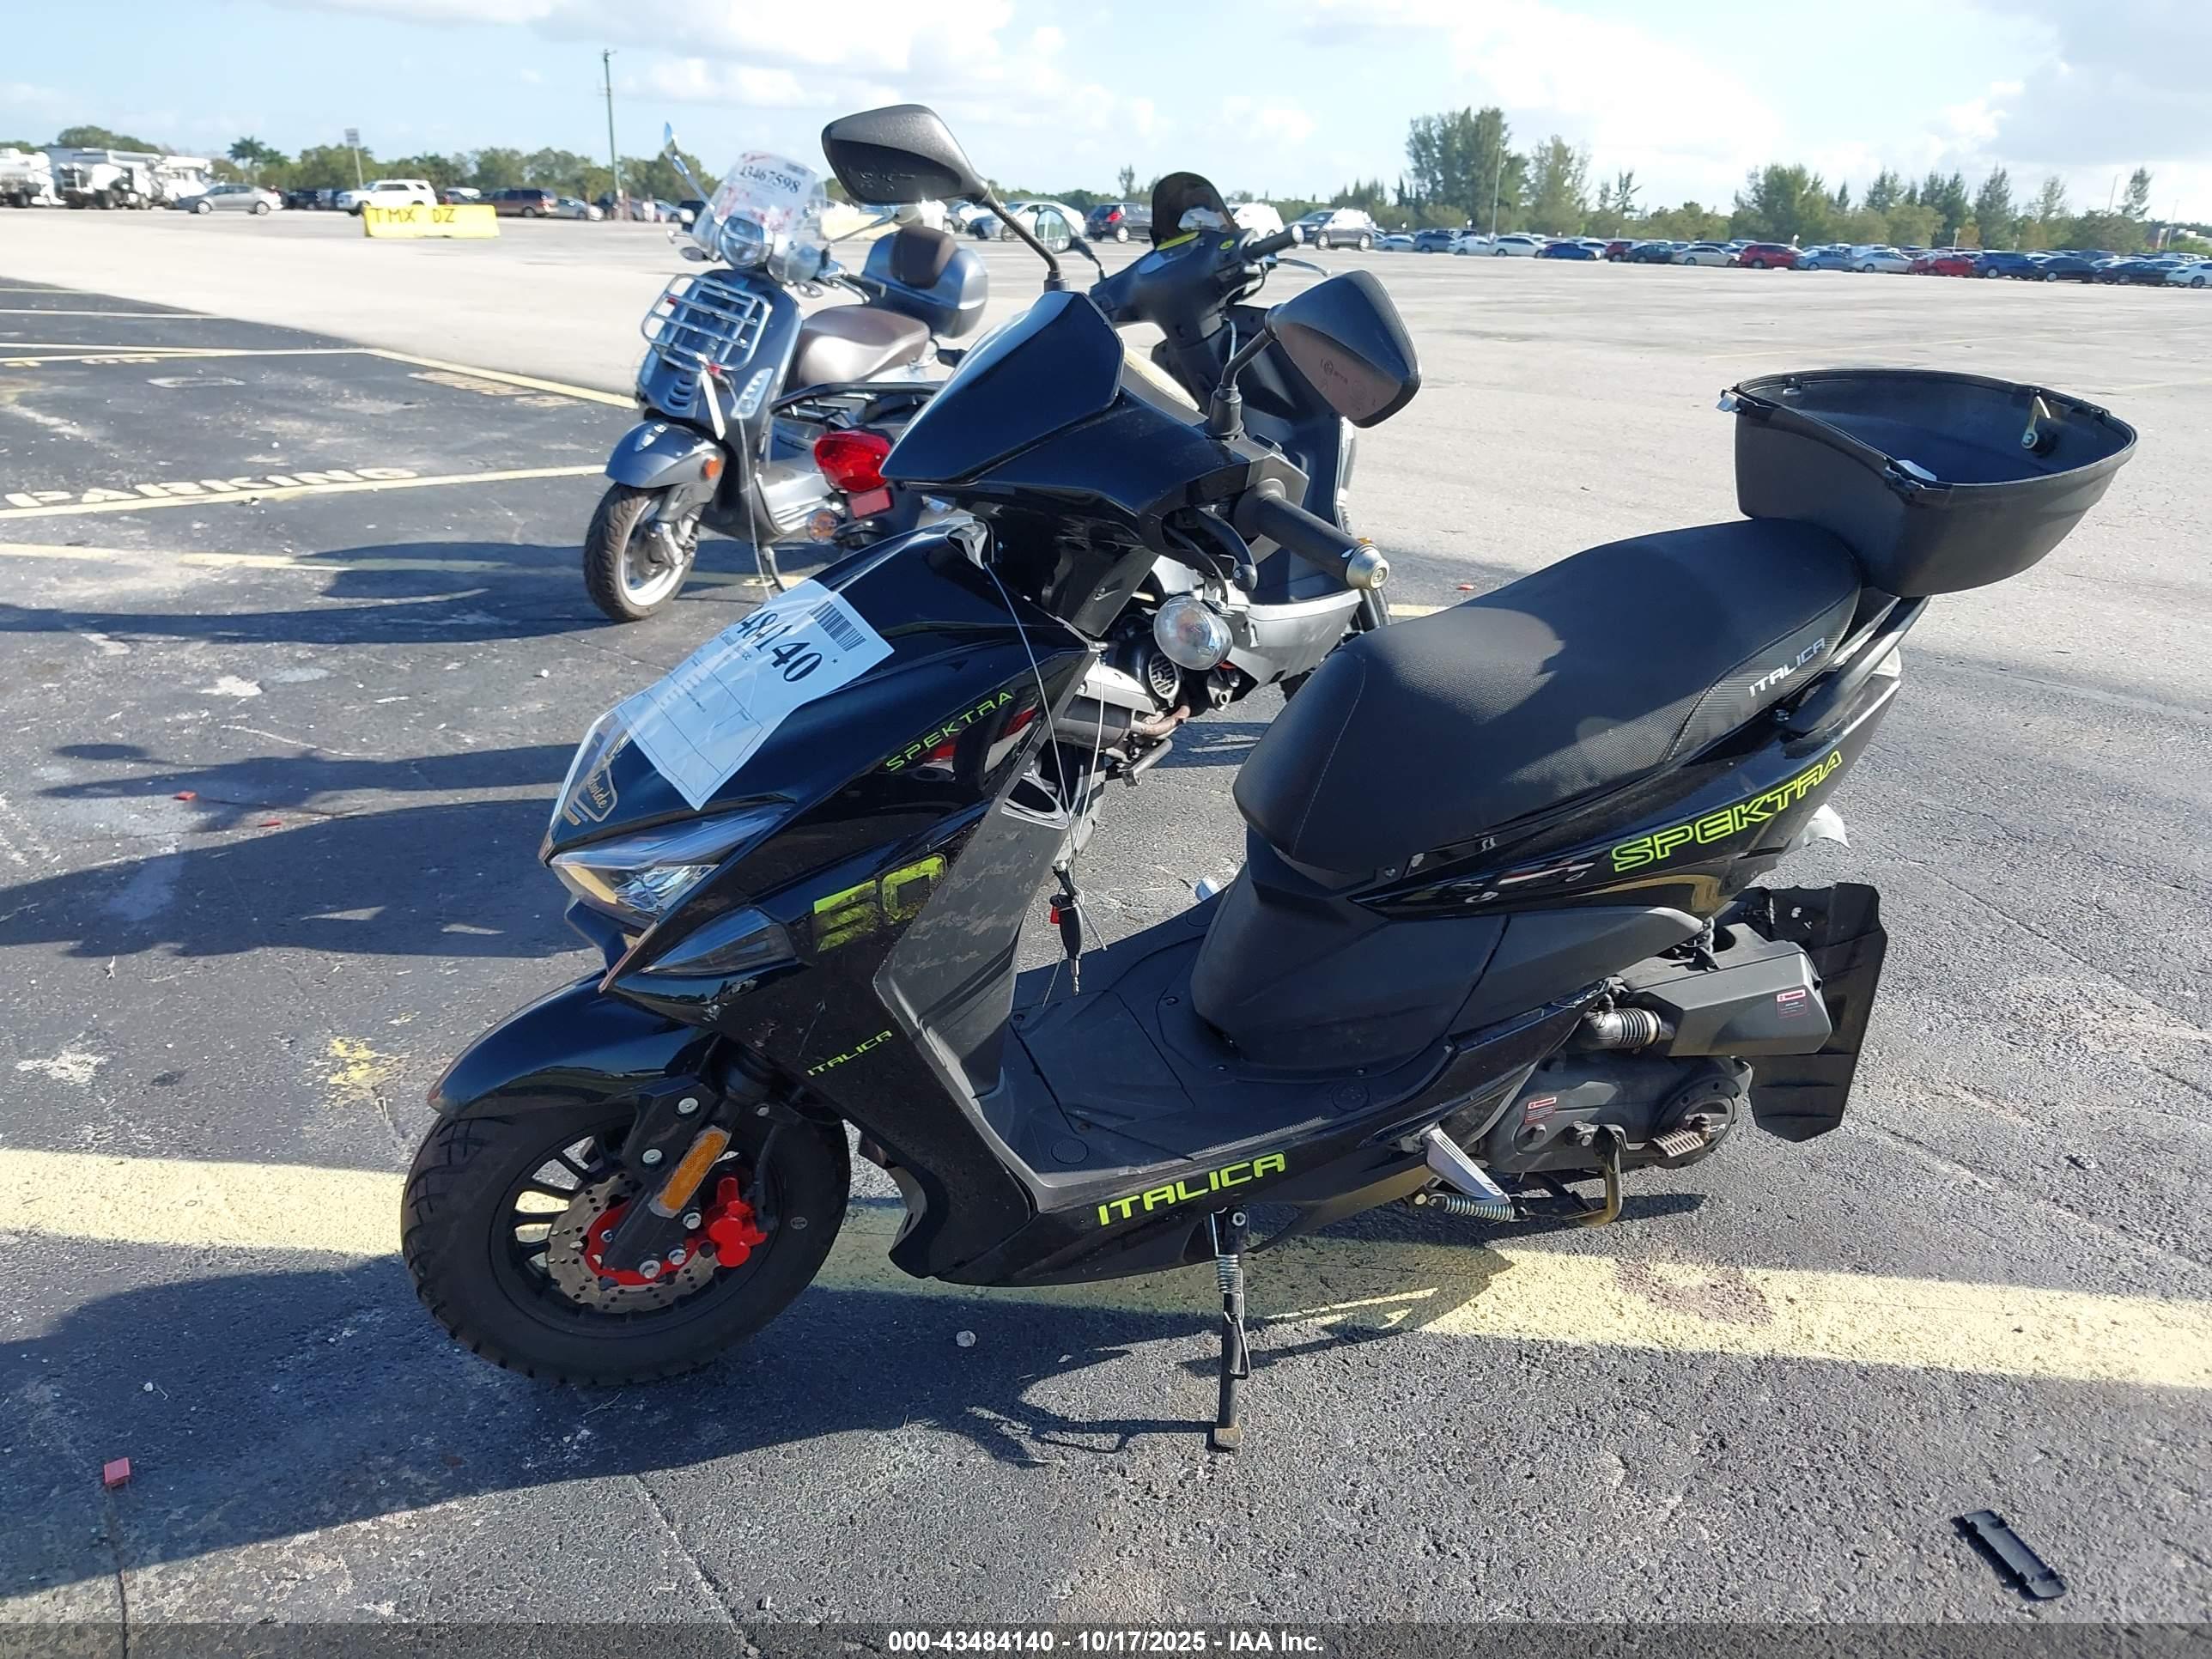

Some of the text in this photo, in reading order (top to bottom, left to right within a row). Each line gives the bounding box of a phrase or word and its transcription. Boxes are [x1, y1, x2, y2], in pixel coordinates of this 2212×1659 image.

[370, 208, 416, 223] TMX
[4, 467, 419, 507] PARKING
[734, 605, 823, 683] 484140
[1749, 637, 1826, 698] ITALICA
[885, 691, 1014, 772] SPEKTRA
[1609, 750, 1843, 873] SPEKTRA
[807, 1030, 893, 1077] ITALICA
[1097, 1152, 1286, 1227] ITALICA
